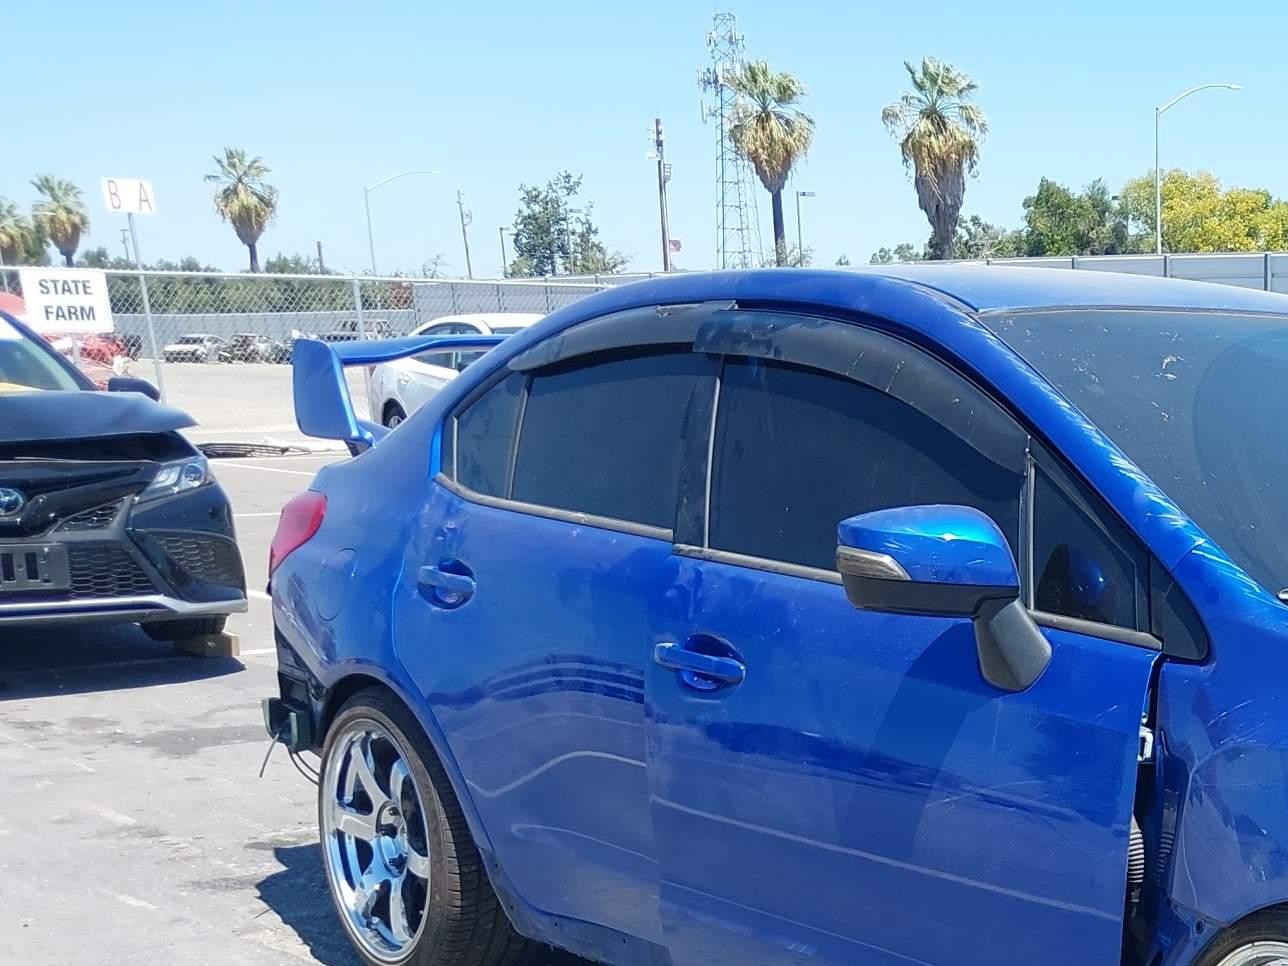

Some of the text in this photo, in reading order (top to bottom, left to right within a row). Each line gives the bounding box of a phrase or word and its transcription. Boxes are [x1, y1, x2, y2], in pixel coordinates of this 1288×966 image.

[107, 179, 153, 212] B A
[38, 278, 94, 296] STATE
[43, 304, 97, 322] FARM
